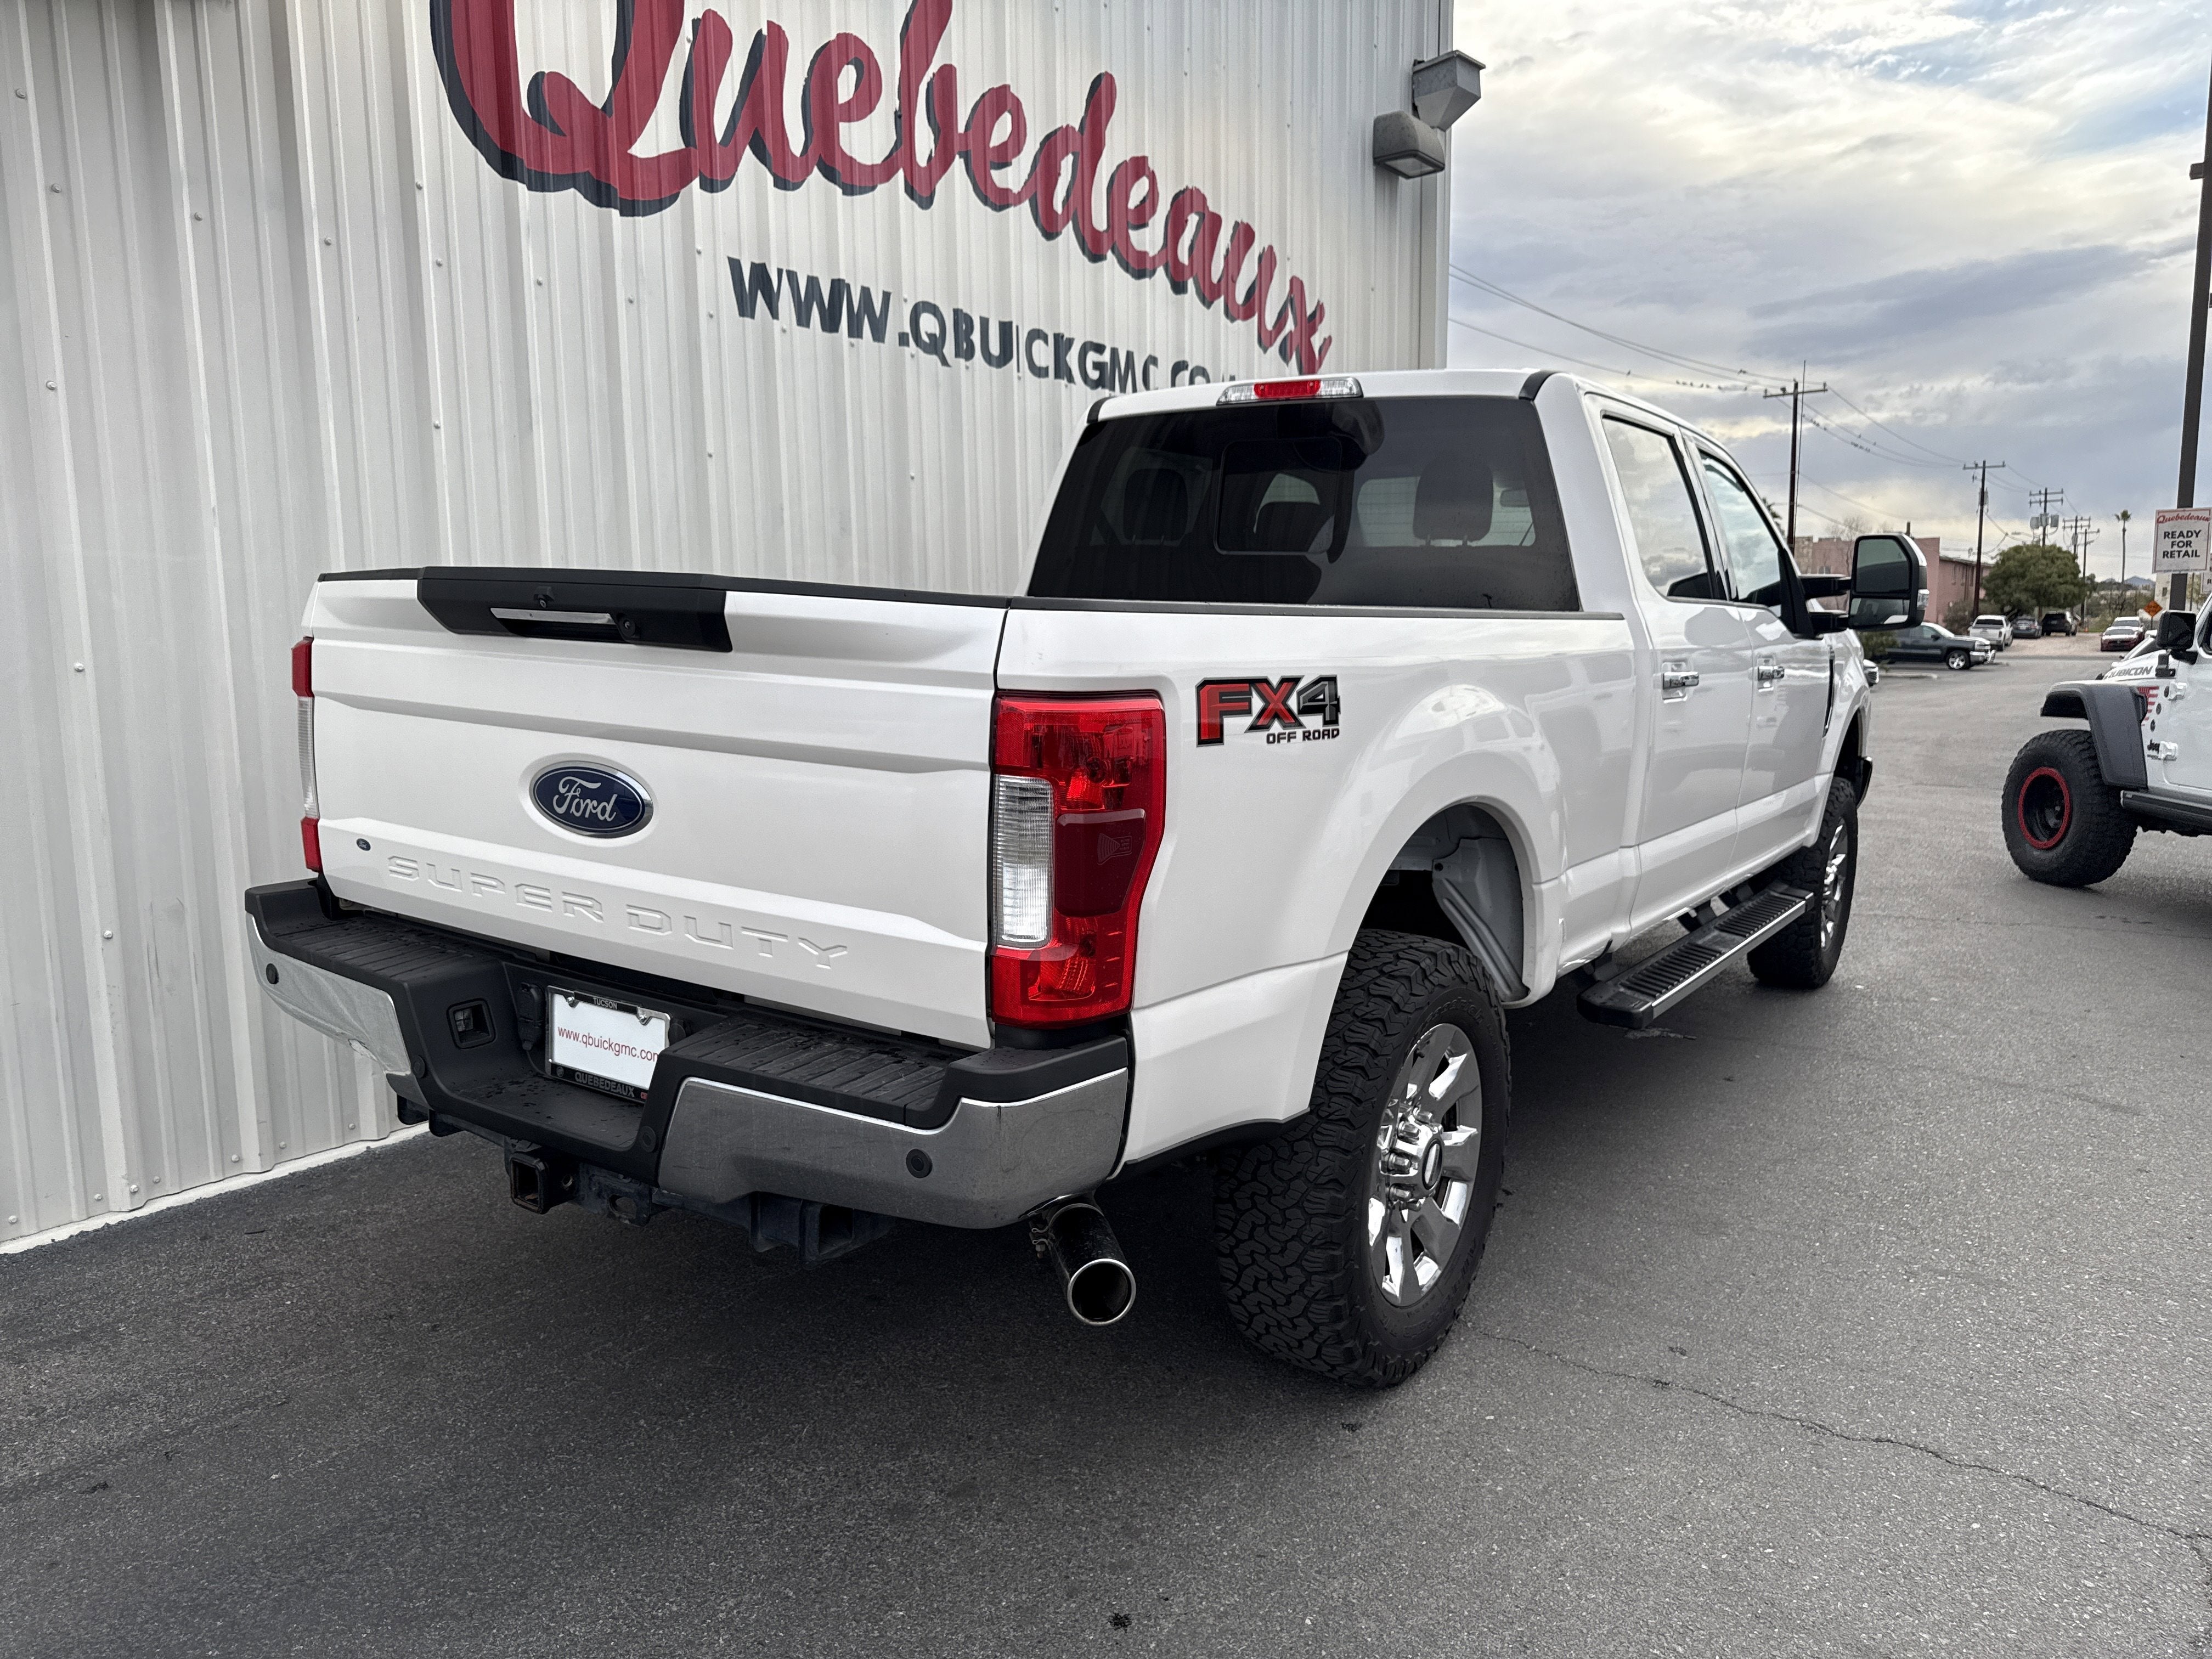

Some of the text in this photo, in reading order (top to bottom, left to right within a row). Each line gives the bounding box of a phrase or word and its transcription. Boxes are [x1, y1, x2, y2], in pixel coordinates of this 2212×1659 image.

[431, 0, 1332, 375] Quebedeaux
[728, 257, 1237, 393] WWW.QBUICKGMCC
[2156, 512, 2210, 524] Quebedeaux
[2163, 529, 2202, 539] READY
[2171, 540, 2192, 549] FOR
[2162, 549, 2200, 559] RETAIL
[1195, 674, 1341, 747] FX4
[1266, 728, 1340, 744] OFF ROAD
[552, 776, 618, 822] Ford
[387, 855, 848, 969] SUPER DUTY
[593, 997, 618, 1010] TUCSON
[574, 1071, 635, 1098] QUEBEDEAUX
